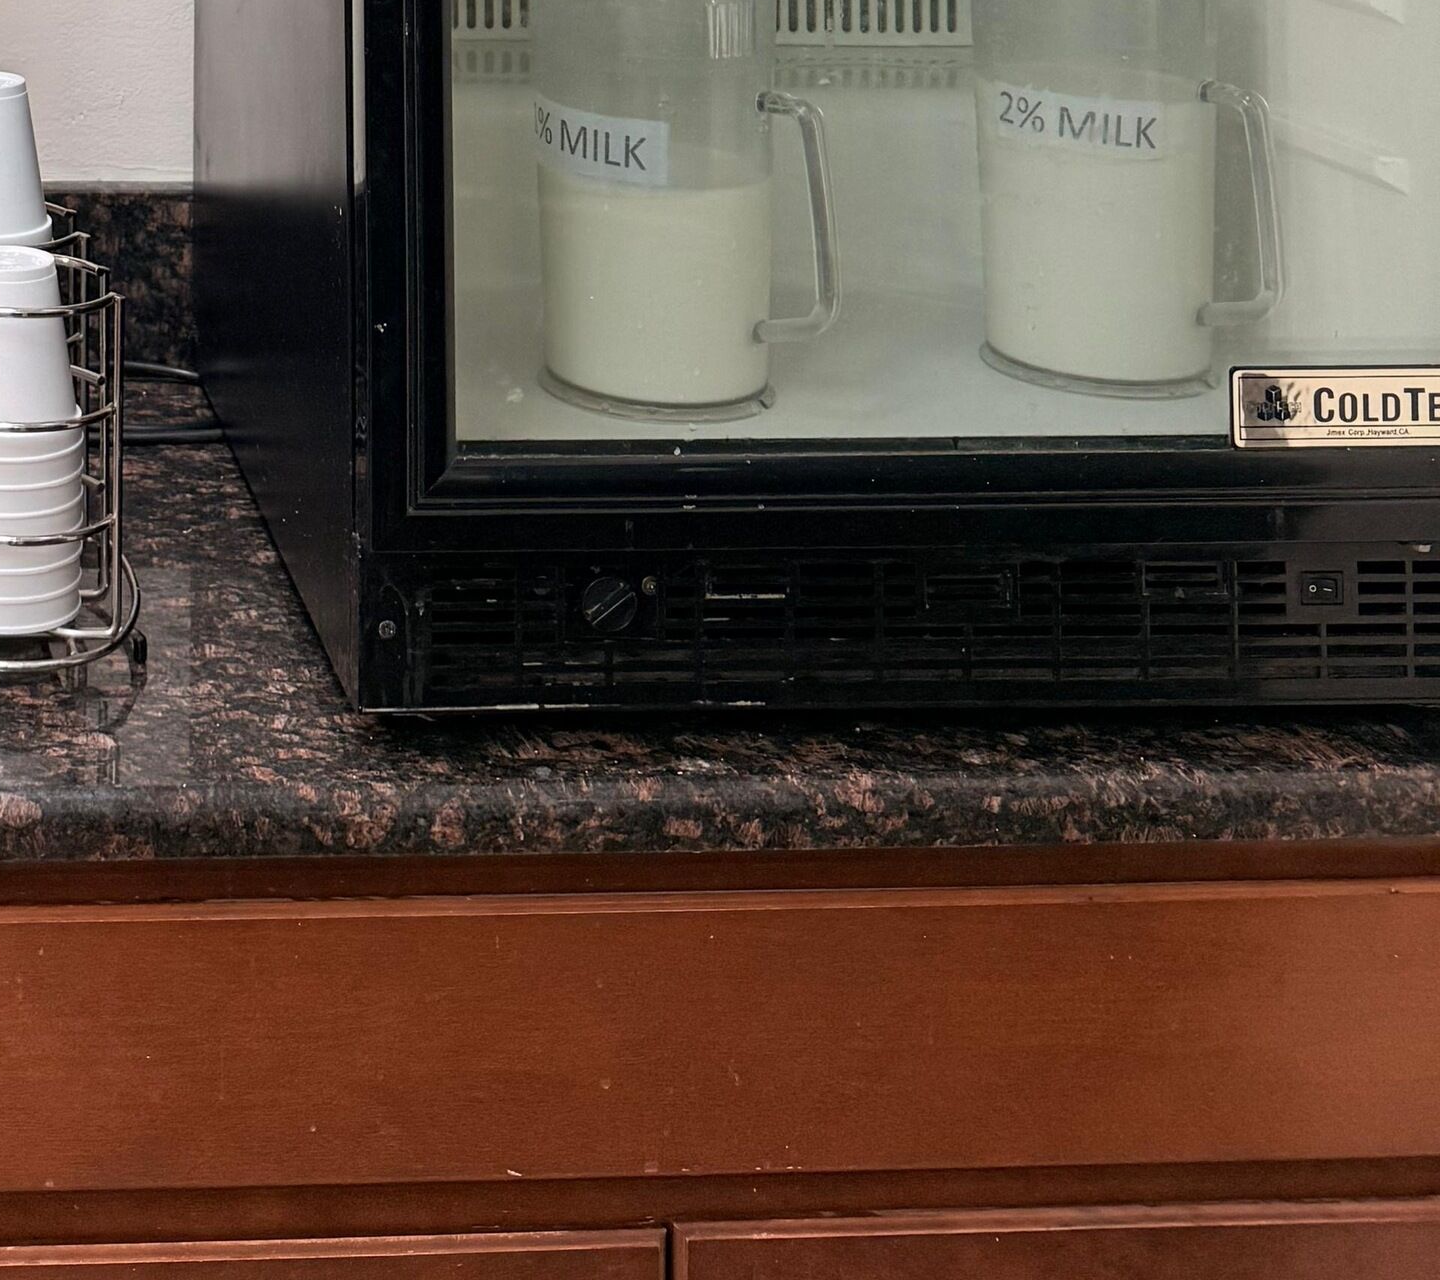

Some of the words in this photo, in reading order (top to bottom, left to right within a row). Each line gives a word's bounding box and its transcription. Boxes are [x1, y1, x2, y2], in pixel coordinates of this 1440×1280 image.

[560, 119, 647, 171] MILK
[999, 91, 1045, 133] 2%
[1059, 106, 1157, 149] MILK
